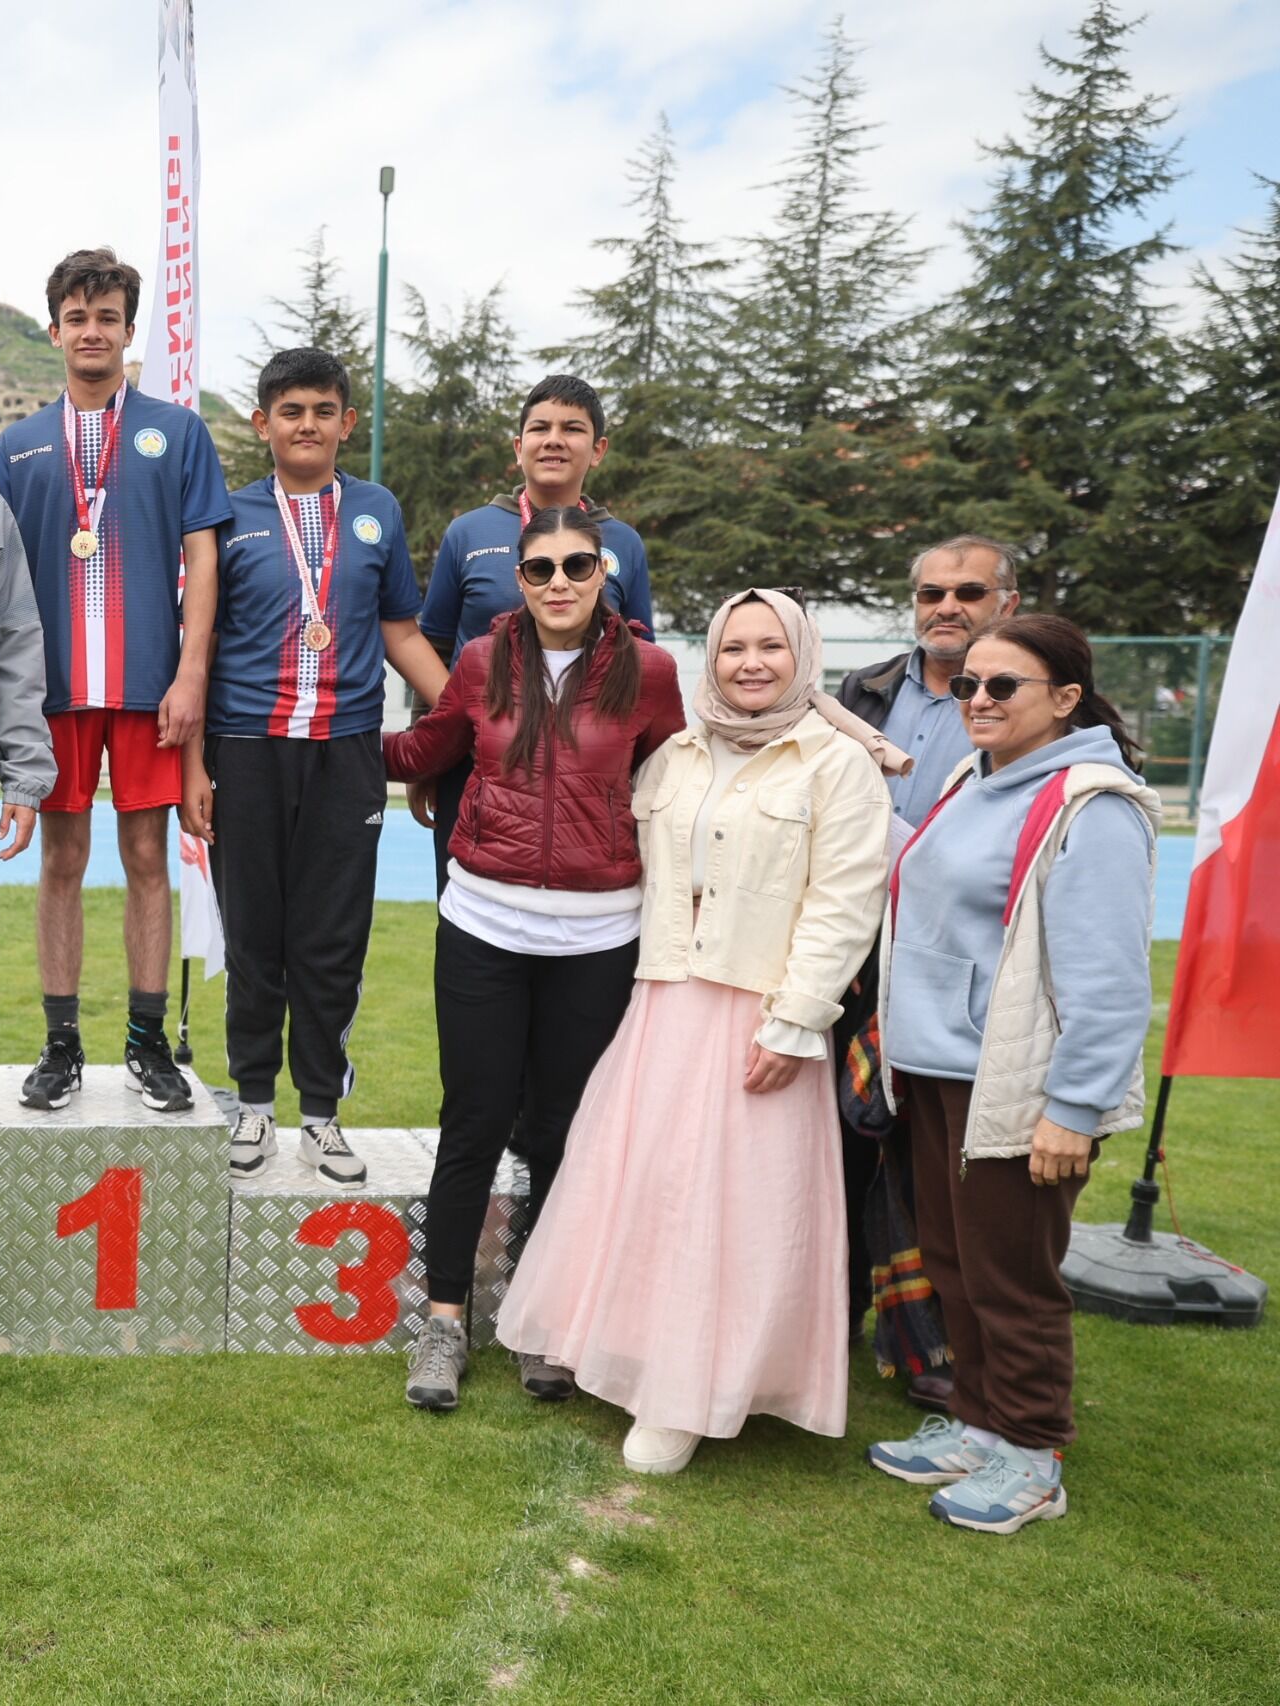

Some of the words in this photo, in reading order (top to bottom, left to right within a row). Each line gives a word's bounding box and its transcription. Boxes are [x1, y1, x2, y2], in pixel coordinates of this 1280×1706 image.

[9, 444, 53, 464] SPORTING
[226, 529, 271, 549] SPORTING
[466, 546, 510, 562] SPORTING
[56, 1167, 142, 1310] 1
[294, 1202, 410, 1345] 3
